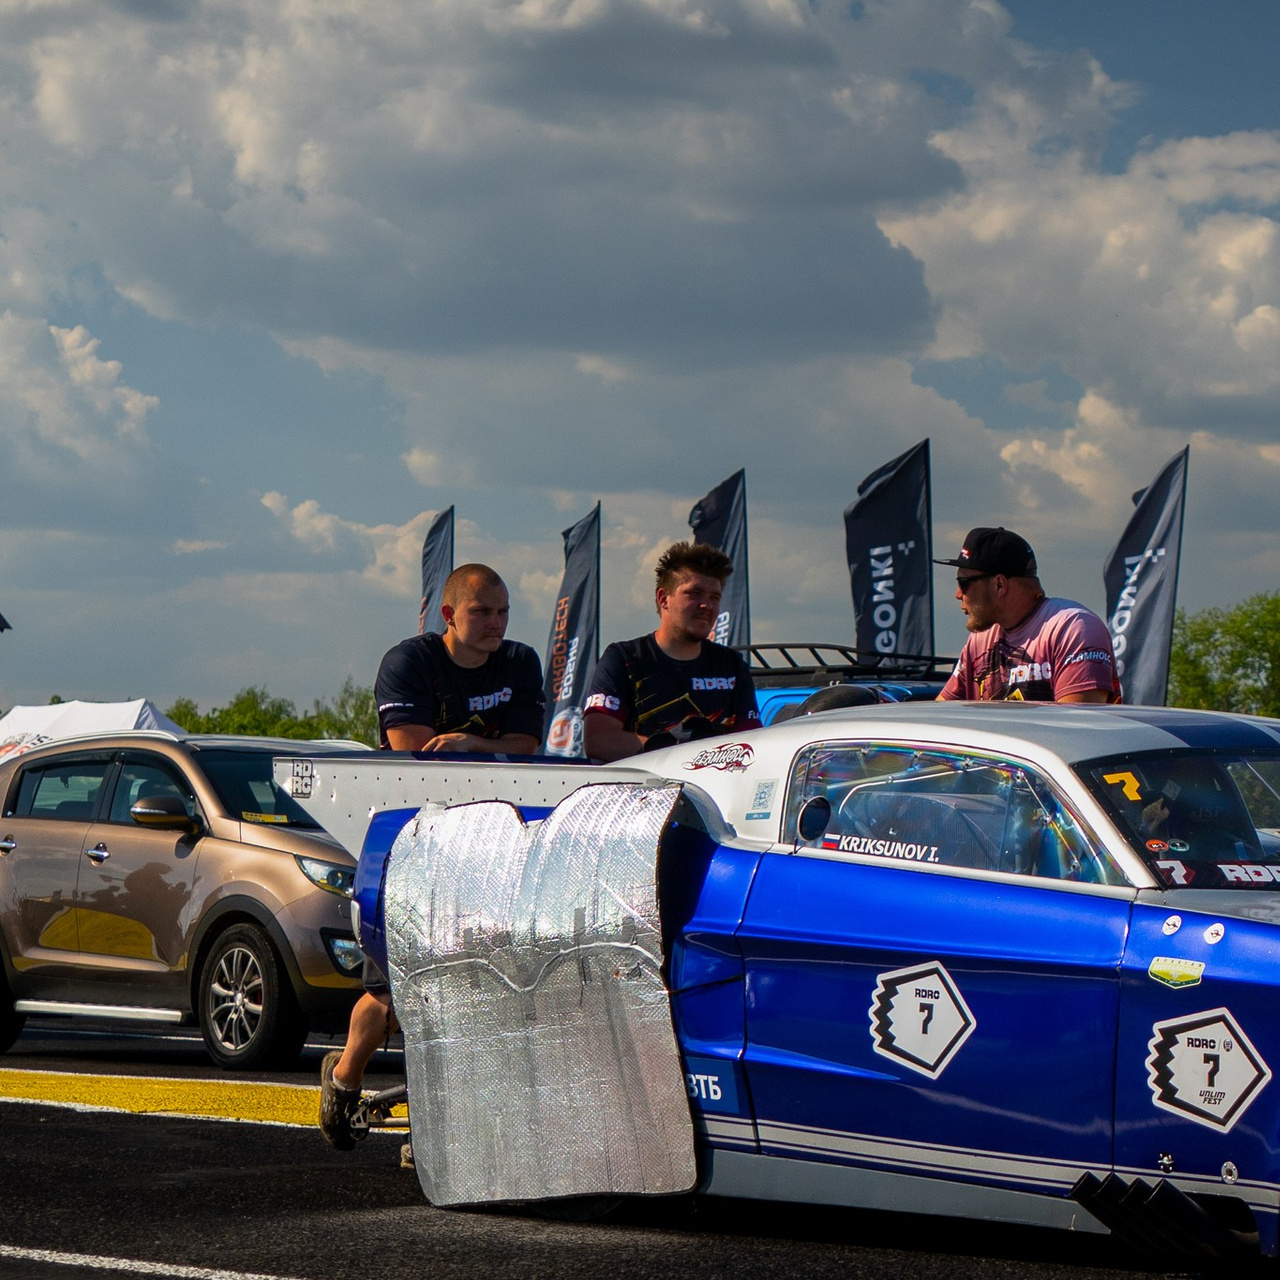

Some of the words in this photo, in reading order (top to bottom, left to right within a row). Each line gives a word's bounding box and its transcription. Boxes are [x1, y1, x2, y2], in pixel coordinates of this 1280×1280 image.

[1102, 771, 1142, 801] 7
[838, 834, 928, 861] KRIKSUNOV
[927, 846, 940, 863] I.
[1155, 860, 1188, 885] 7
[914, 987, 941, 1000] RDRC
[918, 1002, 934, 1035] 7
[1186, 1036, 1217, 1050] RDRC
[1202, 1052, 1220, 1088] 7
[685, 1073, 723, 1100] ВТБ
[1202, 1097, 1223, 1106] FEST
